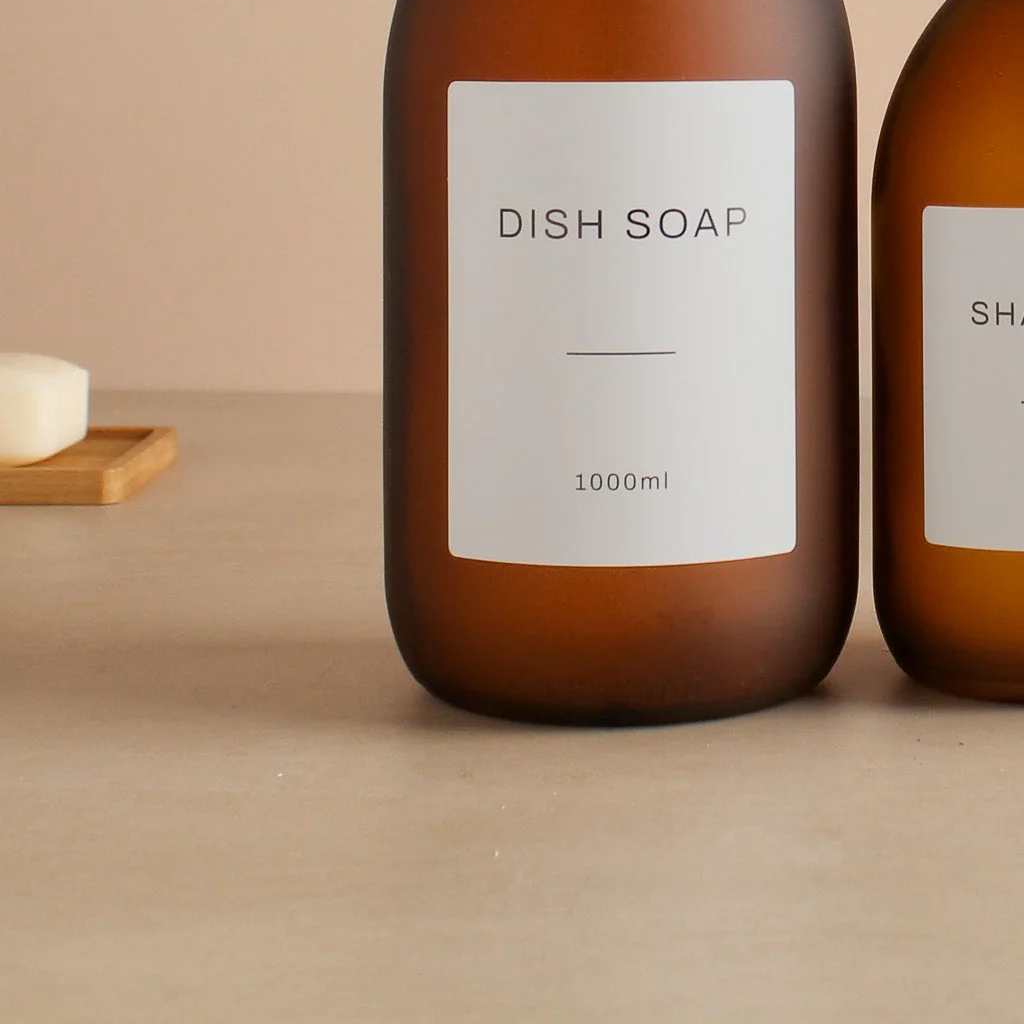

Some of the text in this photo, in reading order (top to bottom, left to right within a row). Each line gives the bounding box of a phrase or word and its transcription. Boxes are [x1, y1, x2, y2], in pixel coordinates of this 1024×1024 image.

[499, 207, 747, 240] DISH SOAP
[575, 471, 668, 492] 1000ml
